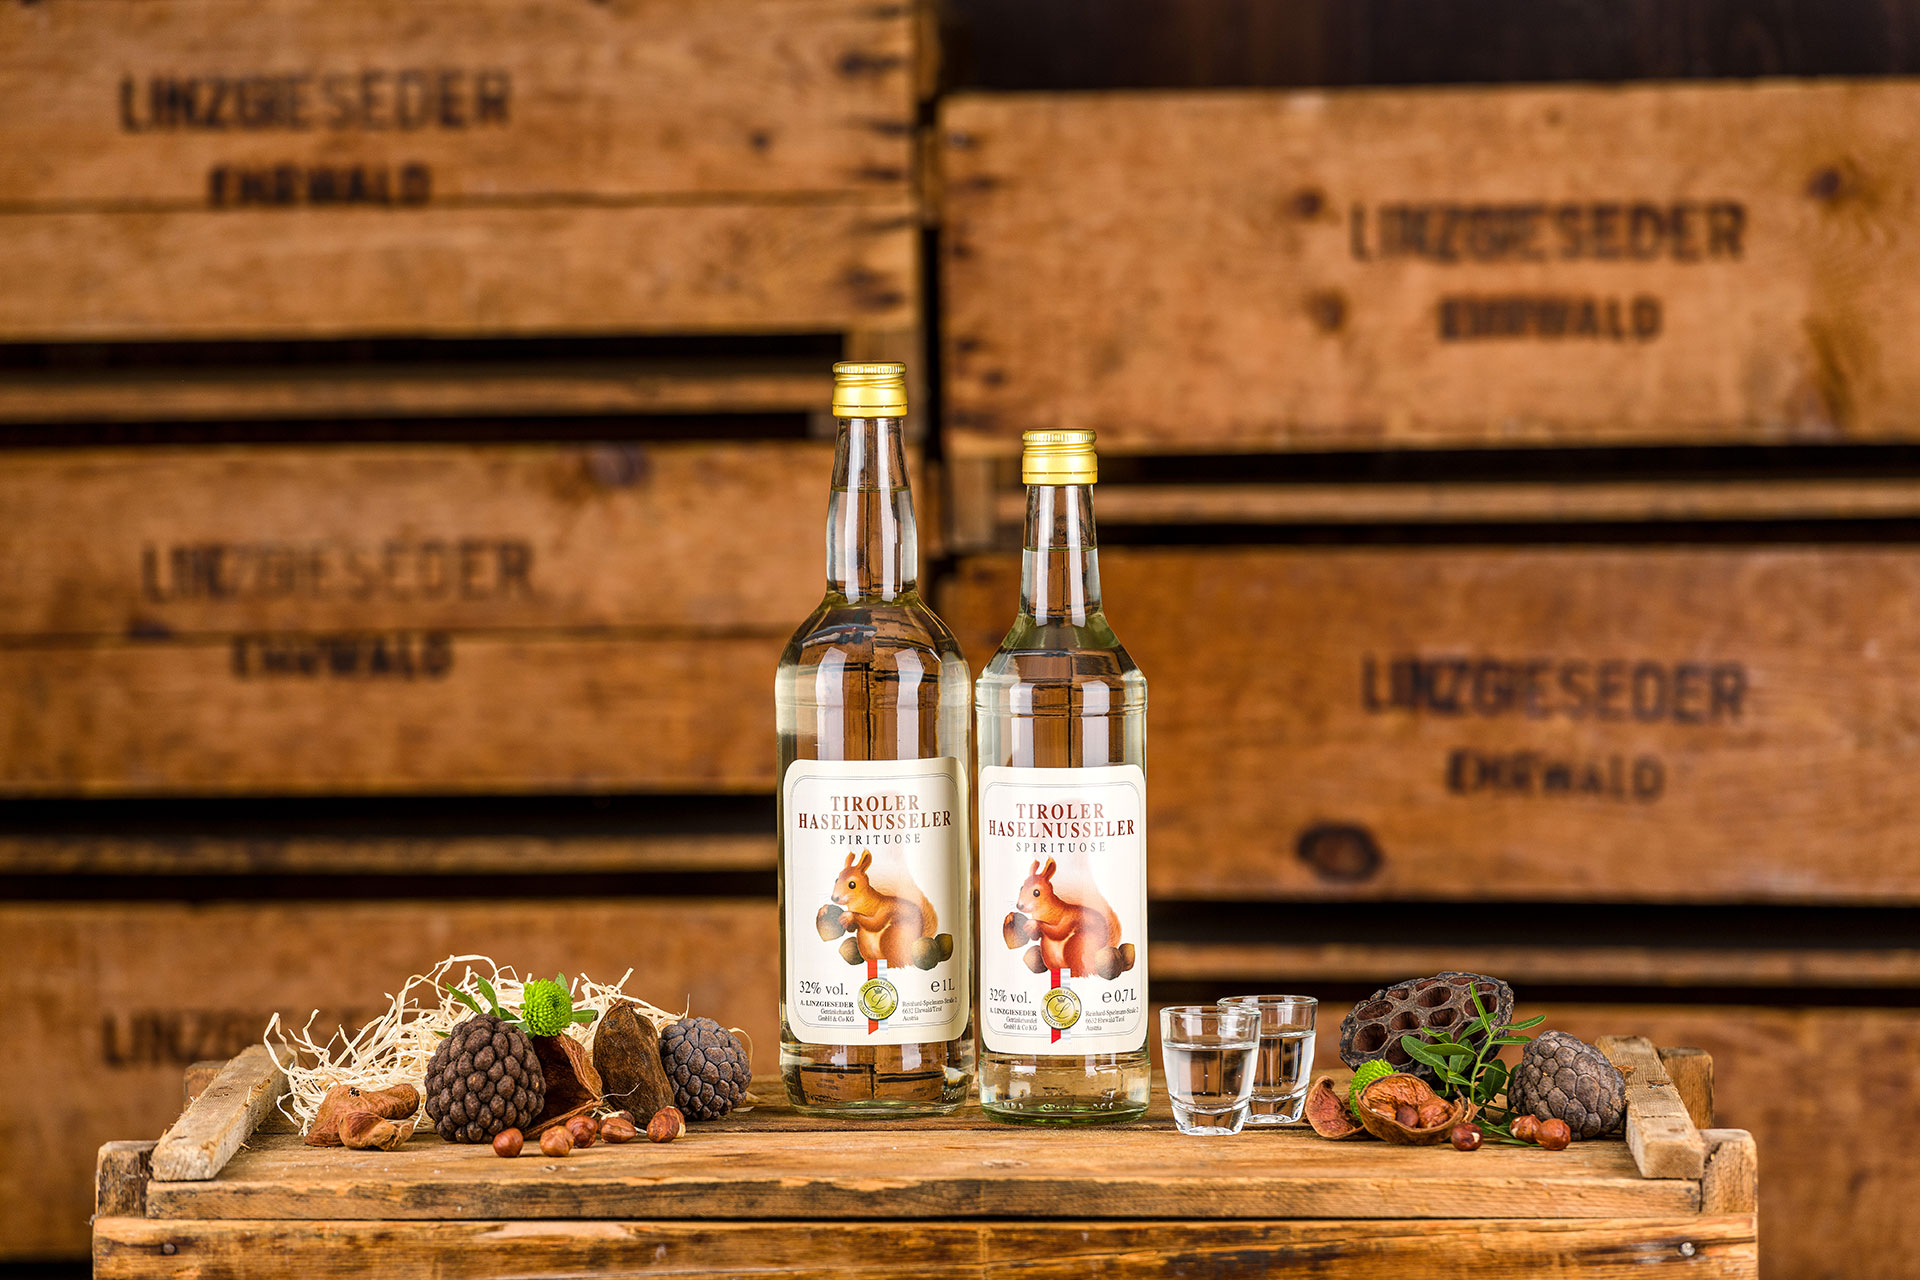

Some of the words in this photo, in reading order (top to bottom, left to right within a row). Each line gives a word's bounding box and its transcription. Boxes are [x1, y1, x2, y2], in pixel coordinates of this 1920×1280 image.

[1362, 656, 1747, 724] LINZGIESEDER
[830, 795, 919, 811] TIROLER
[1016, 803, 1104, 820] TIROLER
[799, 810, 951, 830] HASELNUSSELER
[989, 819, 1134, 838] HASELNUSSELER
[830, 833, 920, 844] SPIRITUOSE
[1016, 841, 1106, 853] SPIRITUOSE
[799, 980, 821, 995] 32%
[825, 982, 848, 995] vol.
[990, 988, 1007, 1002] 32%
[1010, 991, 1031, 1003] vol.
